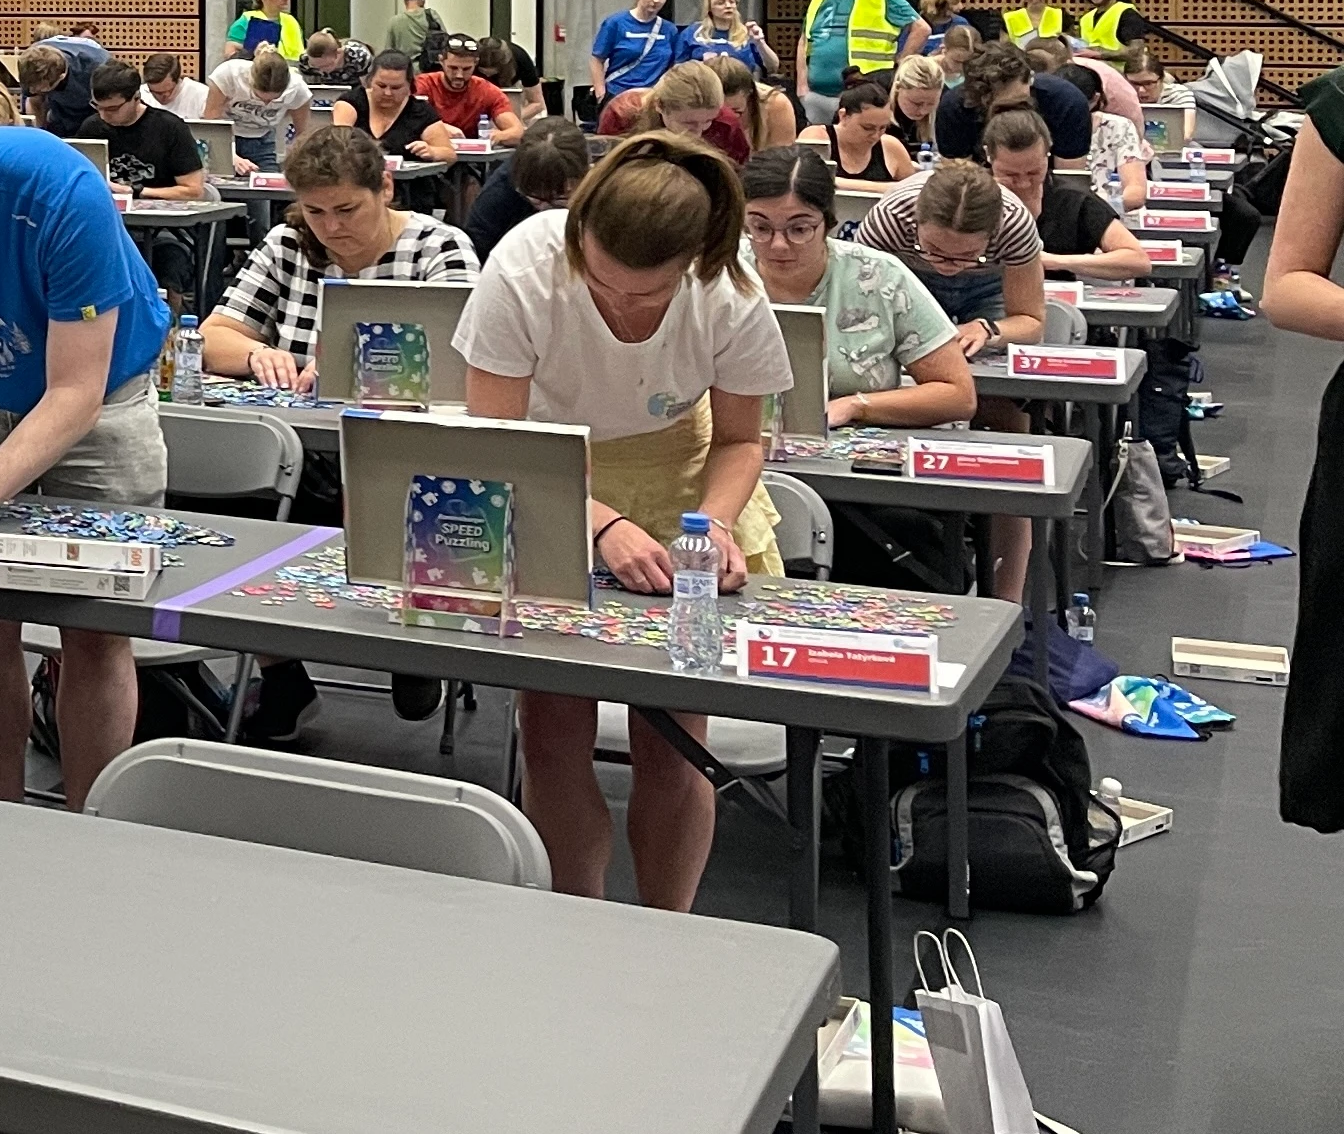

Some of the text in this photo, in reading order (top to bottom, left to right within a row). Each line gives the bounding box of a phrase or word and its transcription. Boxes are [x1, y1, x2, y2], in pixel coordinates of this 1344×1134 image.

[1019, 356, 1042, 369] 37
[922, 454, 950, 470] 27
[441, 523, 483, 537] SPEED
[435, 534, 490, 552] Puzzling
[761, 646, 797, 667] 17
